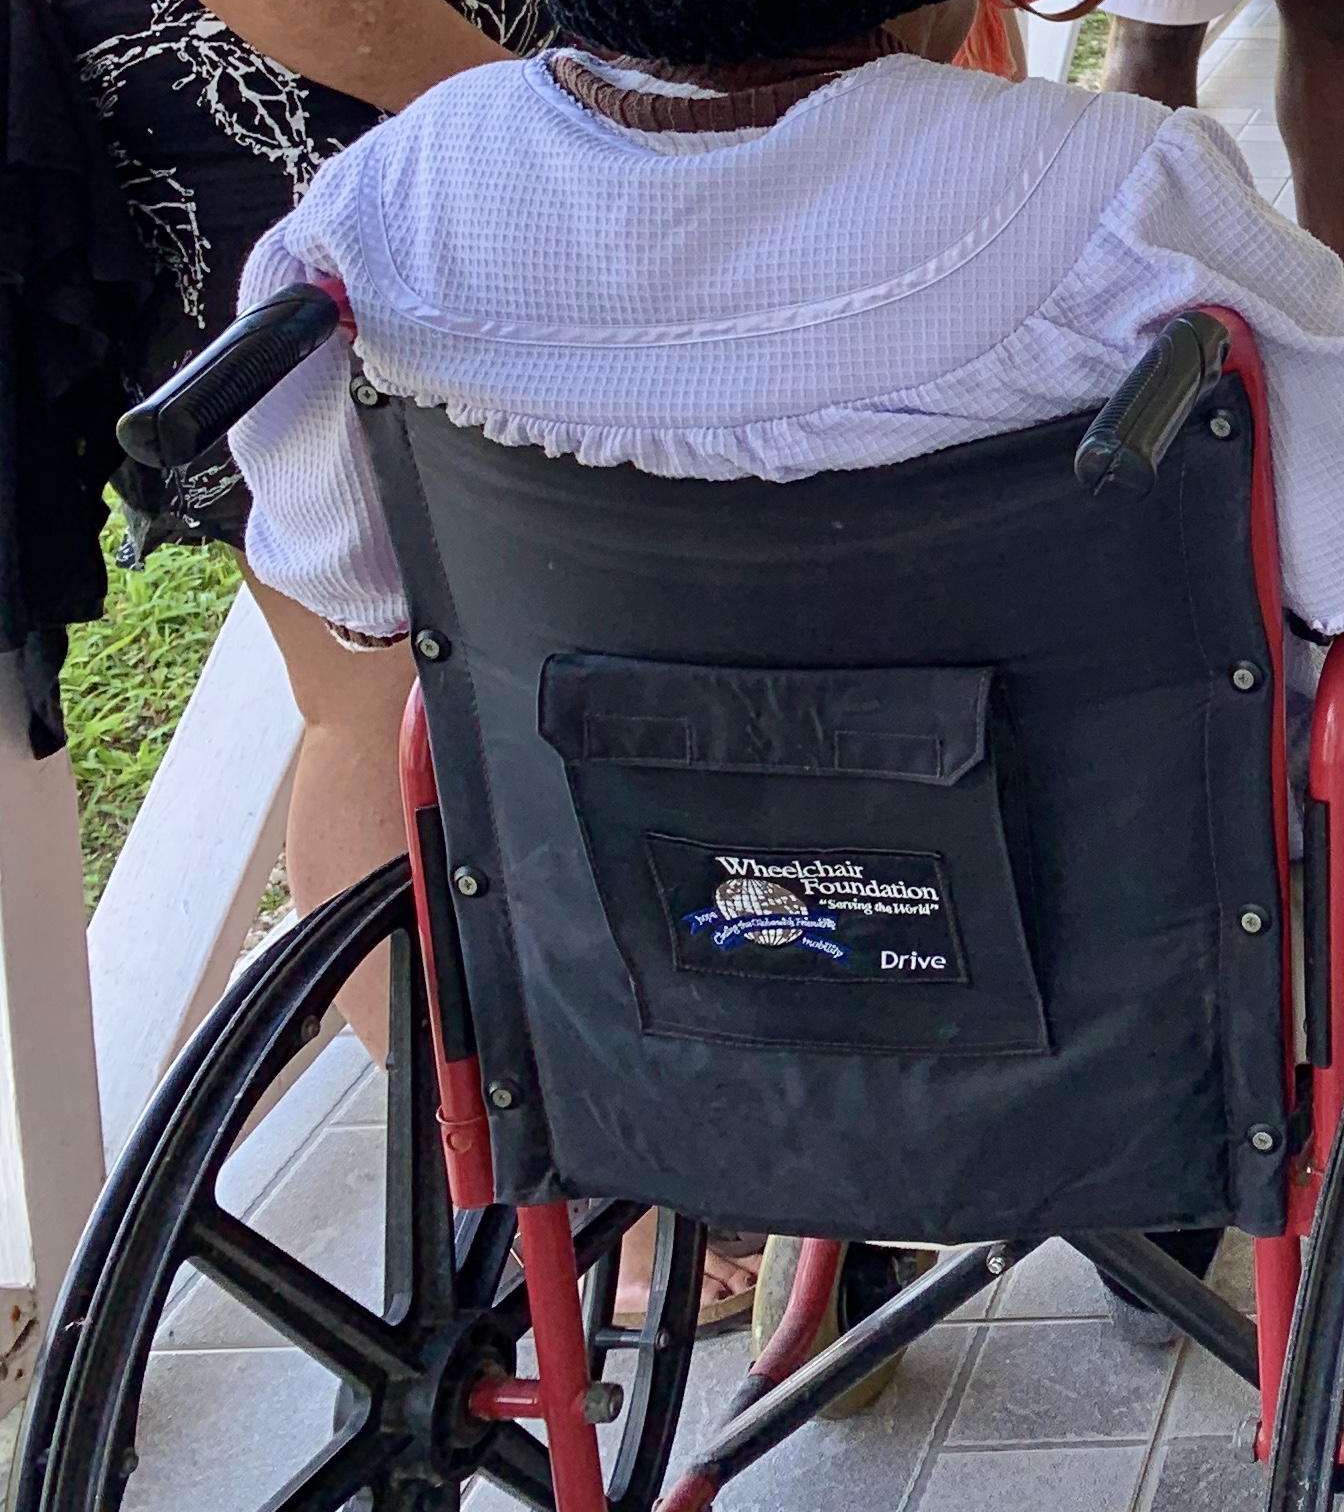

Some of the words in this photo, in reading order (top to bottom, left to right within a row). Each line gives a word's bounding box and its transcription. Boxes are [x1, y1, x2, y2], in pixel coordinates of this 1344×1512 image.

[715, 856, 864, 878] Wheelchair
[801, 878, 939, 901] Foundation
[875, 902, 891, 913] the
[802, 937, 844, 959] mobility
[881, 950, 946, 970] Drive
